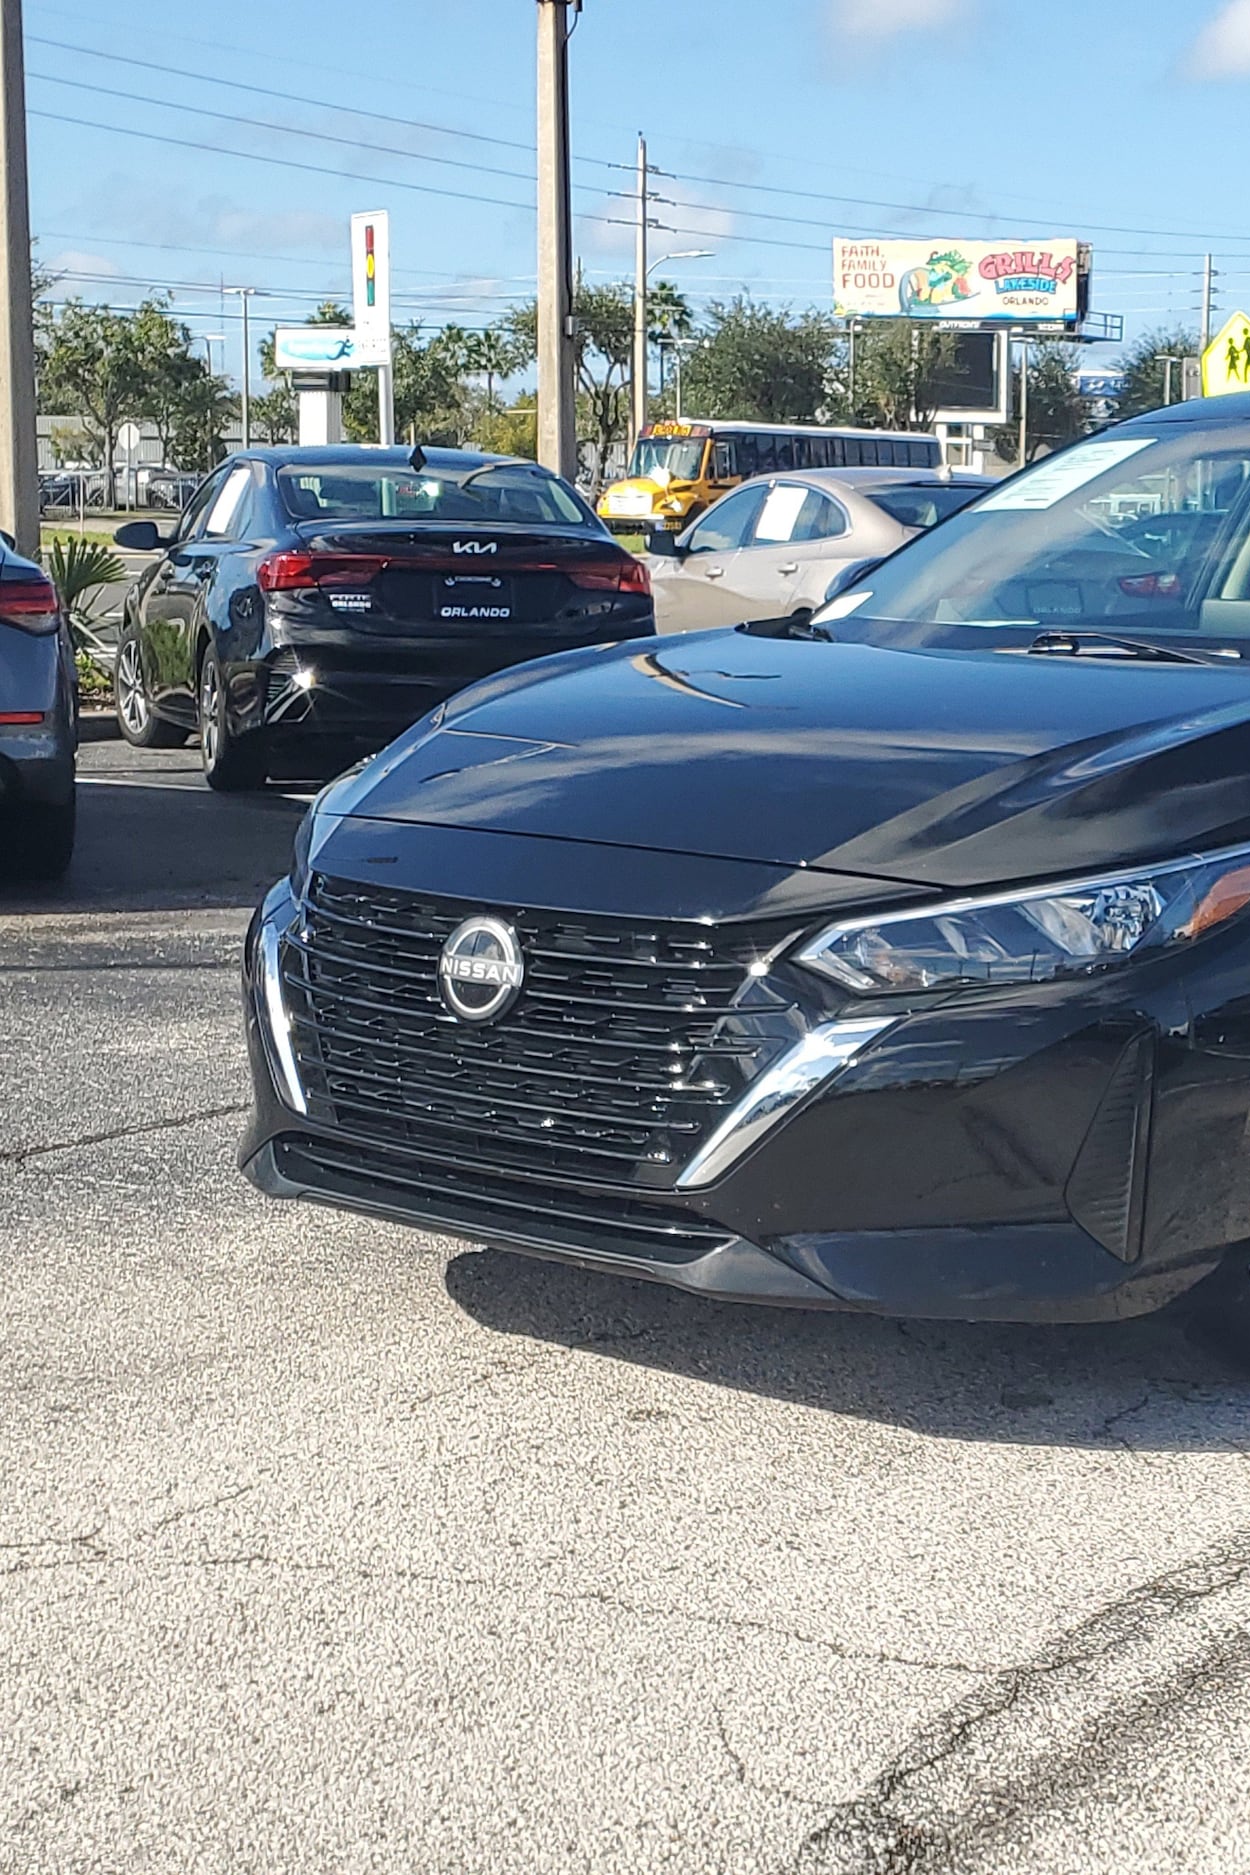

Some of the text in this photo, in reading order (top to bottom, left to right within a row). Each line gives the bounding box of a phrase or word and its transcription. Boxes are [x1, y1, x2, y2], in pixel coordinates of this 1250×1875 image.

[841, 259, 887, 271] FAMILY
[978, 251, 1077, 284] GRILLS
[842, 272, 895, 289] FOOD
[994, 276, 1058, 295] LAKESIDE
[1002, 296, 1049, 306] ORLANDO
[453, 541, 497, 554] KIA
[441, 606, 511, 618] ORLANDO
[442, 957, 518, 984] NISSAN
